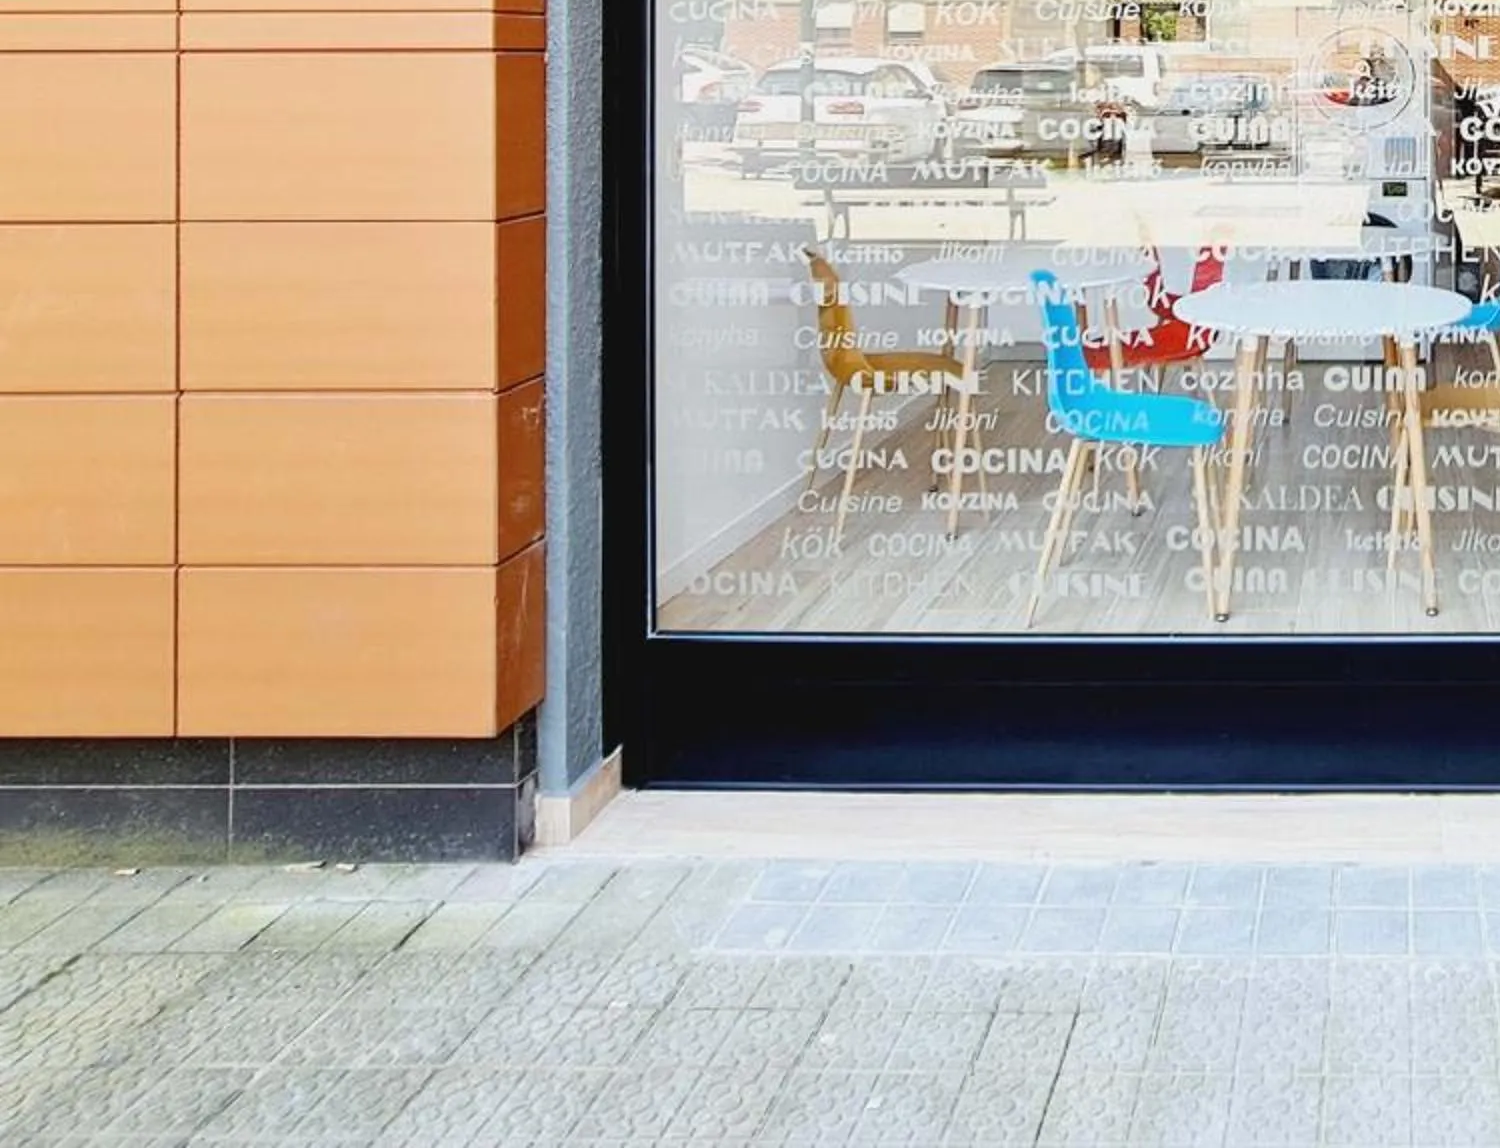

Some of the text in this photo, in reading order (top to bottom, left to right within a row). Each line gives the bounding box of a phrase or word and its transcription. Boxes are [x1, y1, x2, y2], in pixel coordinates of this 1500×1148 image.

[794, 325, 898, 349] Cuisine
[851, 370, 990, 395] CUISINE
[1013, 369, 1159, 395] KITCHEN
[1313, 403, 1408, 428] Cuisin
[931, 448, 1069, 474] COCINA
[999, 530, 1139, 554] MUFAK
[689, 571, 799, 597] OCINA
